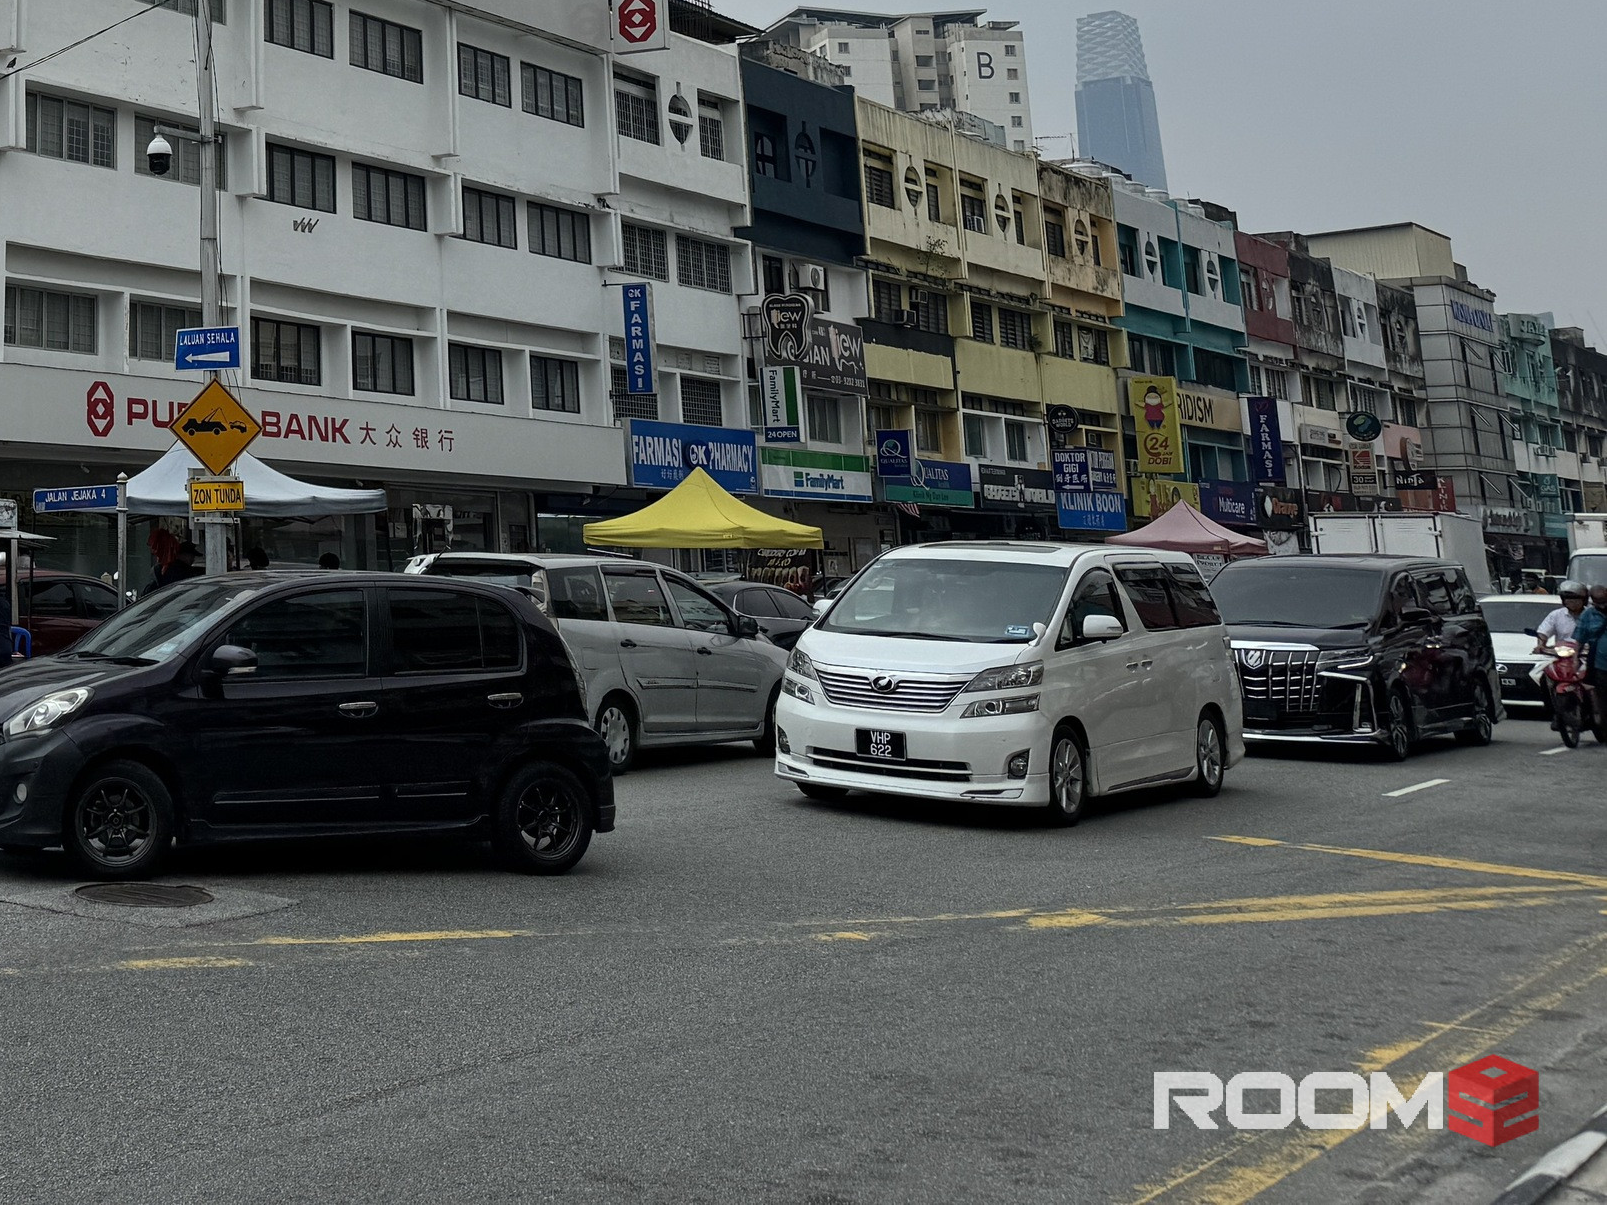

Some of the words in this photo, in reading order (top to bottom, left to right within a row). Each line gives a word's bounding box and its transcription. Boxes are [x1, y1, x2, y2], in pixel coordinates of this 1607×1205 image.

[977, 52, 995, 79] B
[180, 334, 205, 346] LALUAN
[206, 332, 236, 345] SEHALA
[630, 301, 645, 388] FARMASI
[768, 369, 780, 424] FamilyMart
[262, 411, 351, 444] BANK
[767, 430, 776, 439] 24
[777, 430, 798, 439] OPEN
[359, 422, 455, 453] 大众银行
[1148, 436, 1169, 451] 24
[1259, 414, 1274, 477] FARMASI
[632, 435, 683, 468] FARMASI
[708, 441, 753, 473] PHARMACY
[1054, 452, 1086, 463] DOKTOR
[1148, 457, 1172, 465] DOBI
[1063, 463, 1079, 473] GIGI
[804, 472, 845, 491] FamilyMart
[45, 491, 68, 503] JALAN
[71, 489, 98, 501] JEJAKA
[101, 489, 107, 499] 4
[194, 489, 212, 504] ZON
[215, 488, 242, 504] TUNDA
[1060, 492, 1095, 511] KLINIK
[1096, 493, 1122, 513] BOON
[869, 730, 890, 744] VHP
[869, 743, 892, 757] 622
